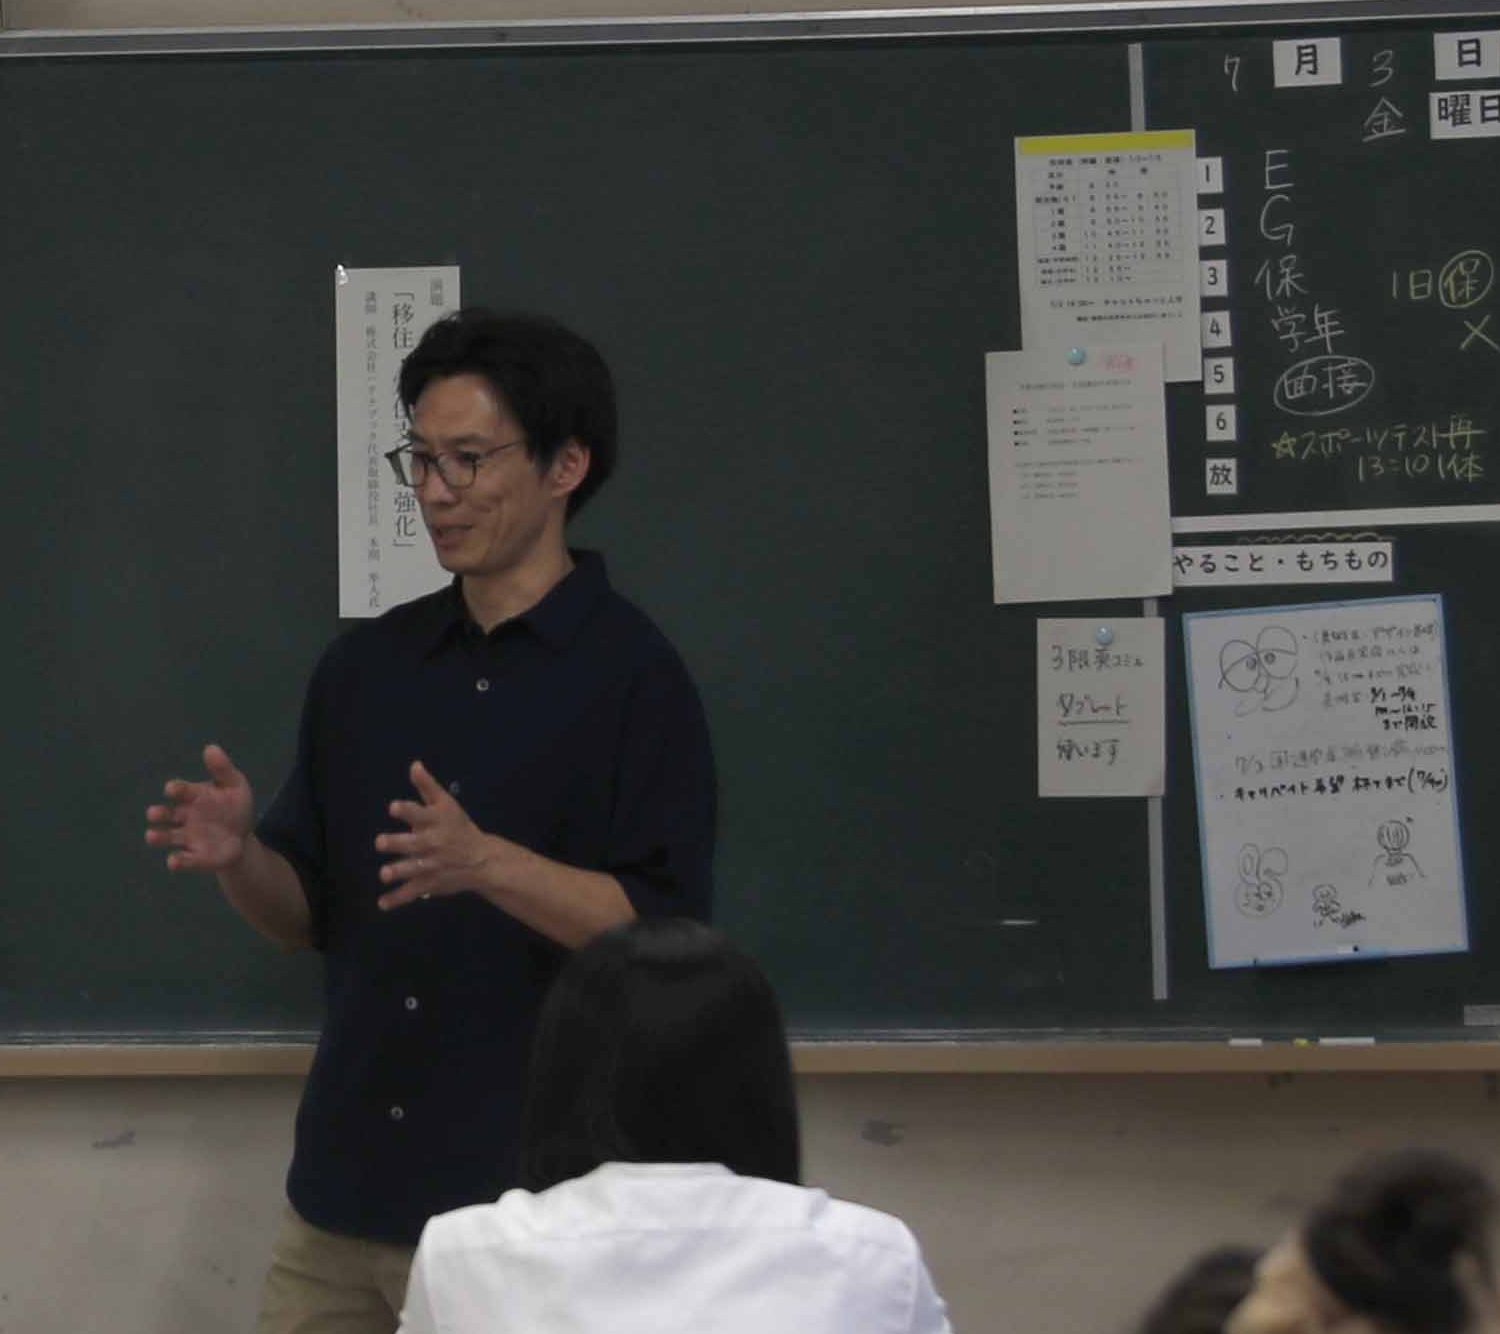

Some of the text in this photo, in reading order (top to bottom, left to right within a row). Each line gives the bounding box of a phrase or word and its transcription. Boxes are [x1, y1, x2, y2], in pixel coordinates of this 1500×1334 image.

[1295, 43, 1320, 75] 月
[1368, 51, 1394, 87] 3
[1458, 38, 1481, 68] 日
[1362, 98, 1407, 141] 金
[1265, 149, 1294, 191] E
[1204, 216, 1216, 235] 2
[1260, 194, 1294, 245] G
[1207, 267, 1218, 286] 3
[1209, 318, 1222, 337] 4
[1271, 304, 1346, 355] 学年
[1213, 365, 1225, 384] 5
[1281, 363, 1370, 401] 面接
[1216, 412, 1227, 431] 6
[1209, 464, 1233, 487] 放
